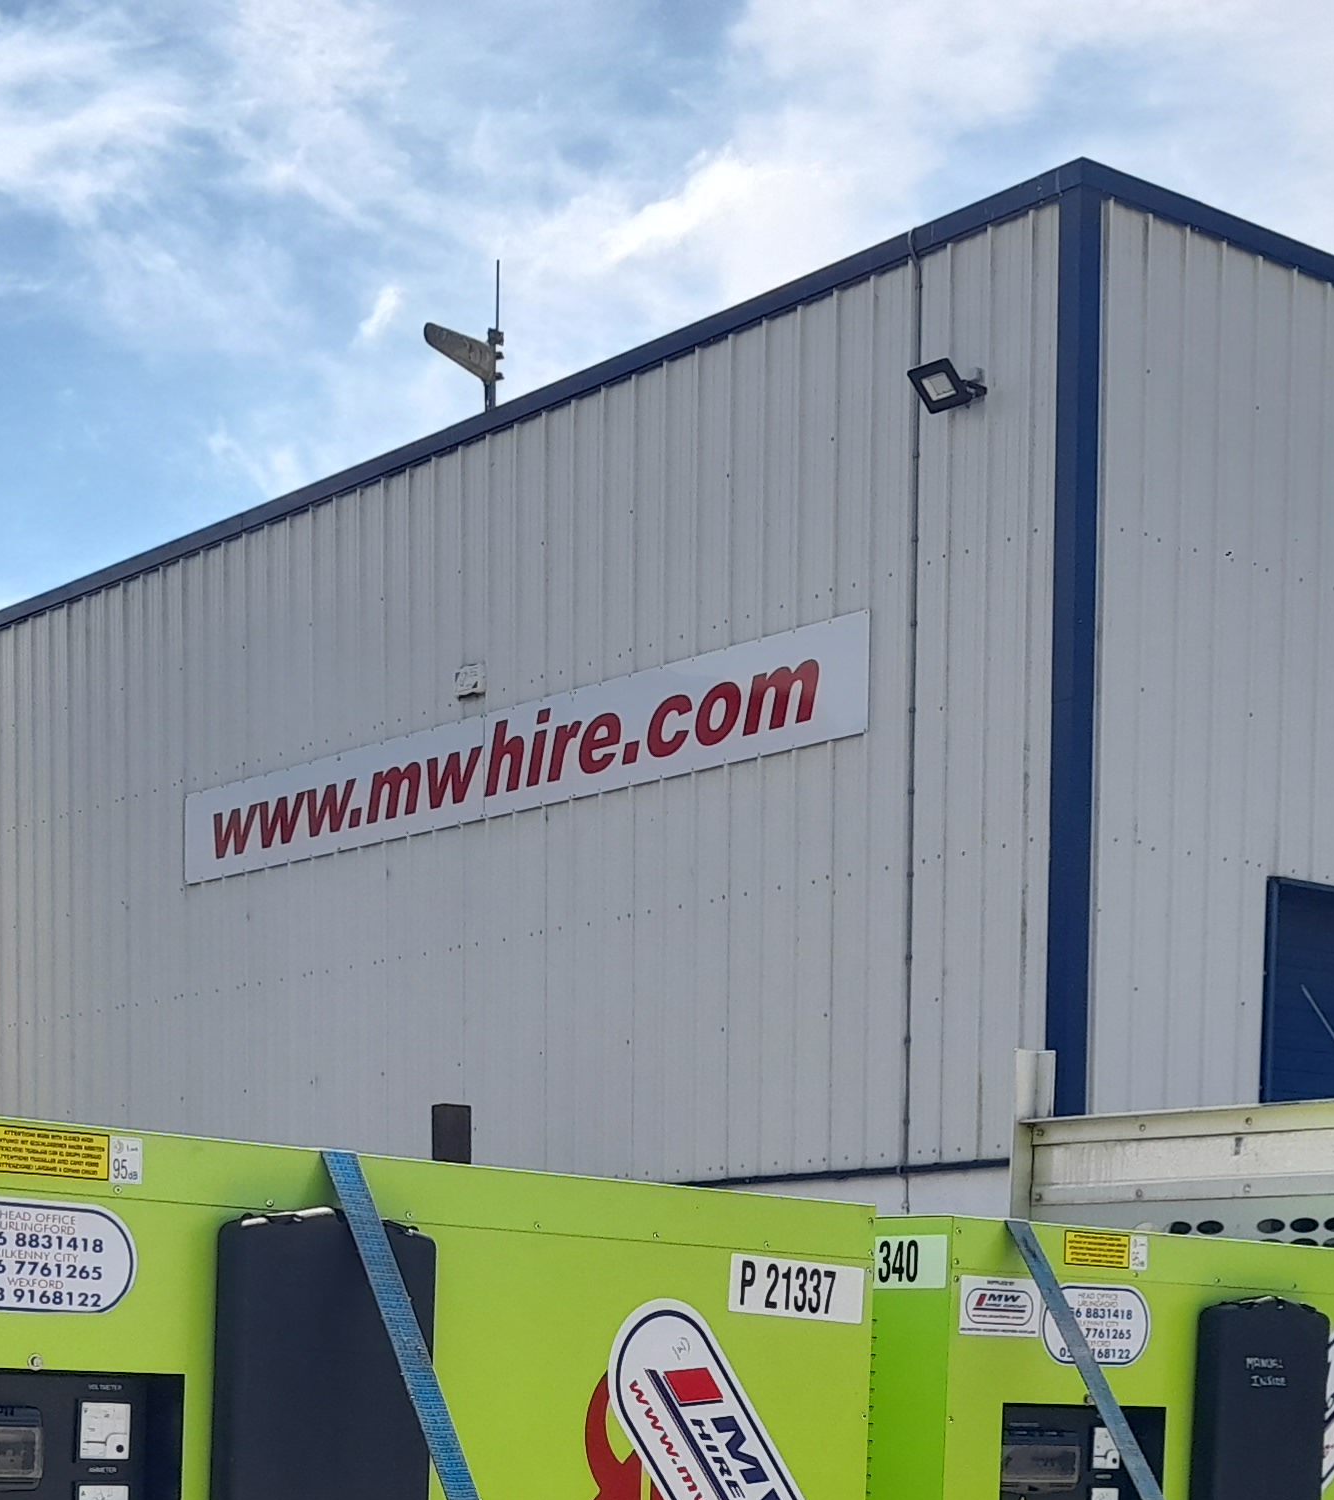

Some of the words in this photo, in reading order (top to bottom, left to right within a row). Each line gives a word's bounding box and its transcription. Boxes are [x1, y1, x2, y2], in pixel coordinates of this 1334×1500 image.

[212, 658, 820, 860] www.mwhire.com
[0, 1209, 31, 1222] HEAD
[35, 1212, 76, 1226] OFFICE
[0, 1221, 76, 1236] URLINGFORD
[14, 1232, 104, 1253] 8831418
[53, 1252, 79, 1264] CITY
[878, 1240, 920, 1283] 340
[14, 1260, 103, 1281] 7761265
[7, 1277, 64, 1290] WEXFORD
[739, 1260, 756, 1306] P
[764, 1263, 837, 1315] 21337
[12, 1287, 101, 1308] 9168122
[1085, 1308, 1133, 1320] 8831418
[1085, 1328, 1132, 1340] 7761265
[689, 1418, 746, 1500] HIRE
